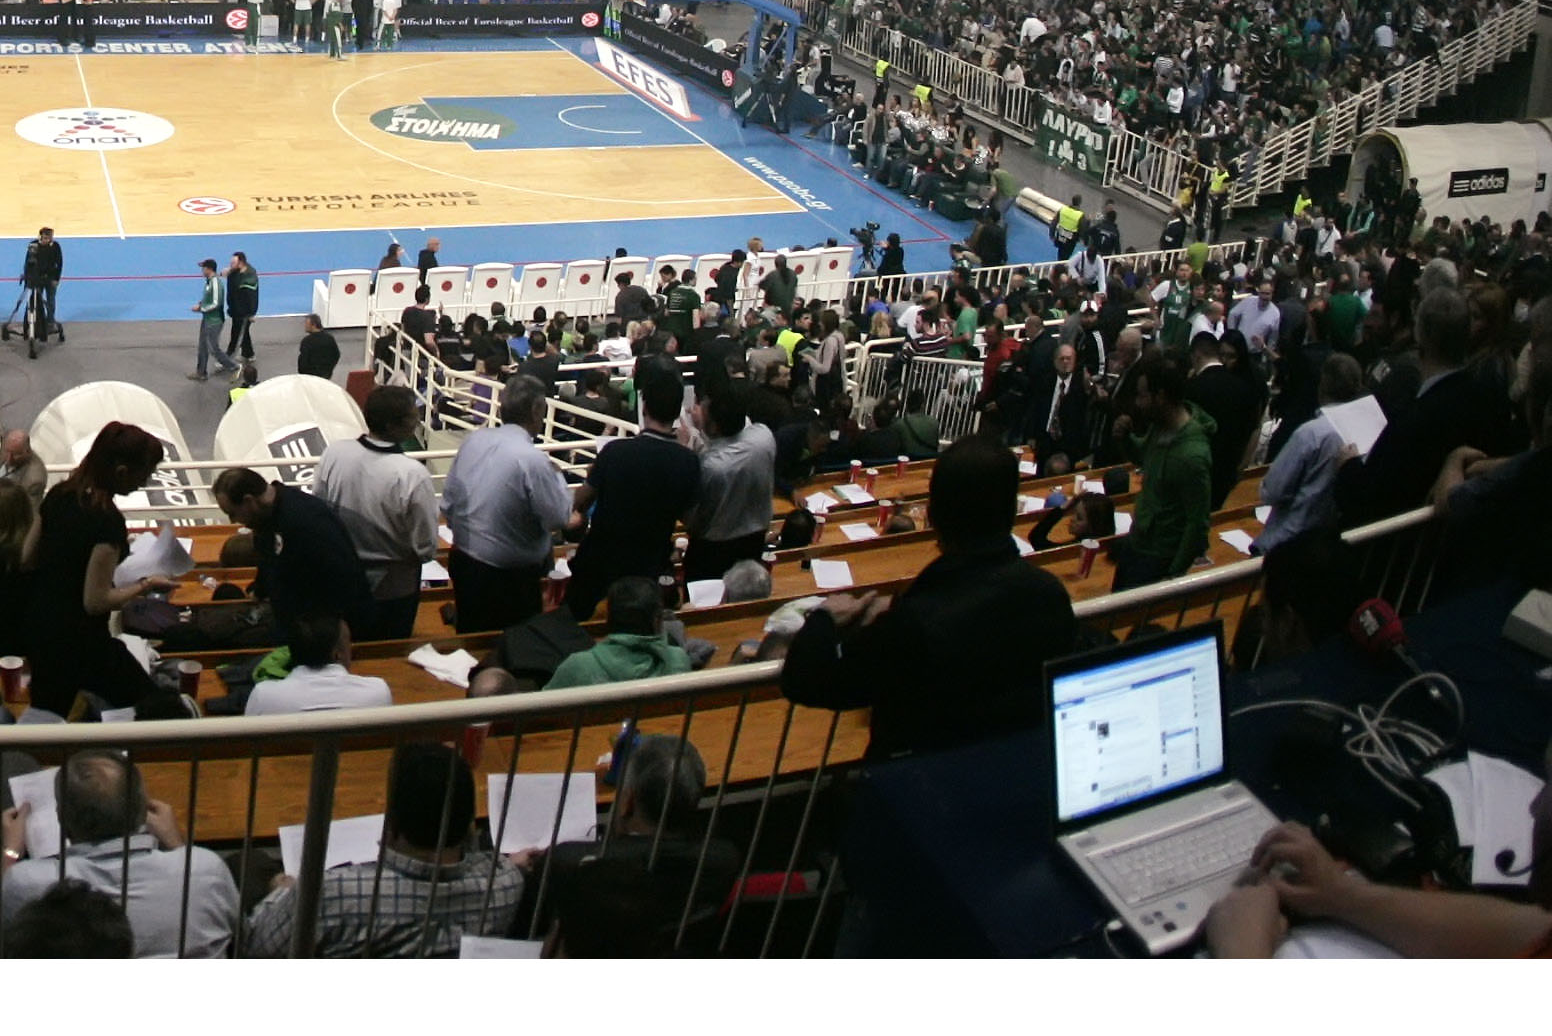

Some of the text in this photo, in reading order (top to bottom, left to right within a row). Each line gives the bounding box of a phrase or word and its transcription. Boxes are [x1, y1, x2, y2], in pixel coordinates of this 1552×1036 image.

[11, 14, 40, 26] Beer
[43, 14, 59, 26] of
[145, 14, 213, 26] Basketball
[92, 42, 193, 54] CENTER
[611, 49, 675, 106] EFES
[1470, 175, 1506, 191] adidas
[250, 191, 479, 203] TURKISH AIRLINES
[254, 199, 481, 212] EUROLEAGUE
